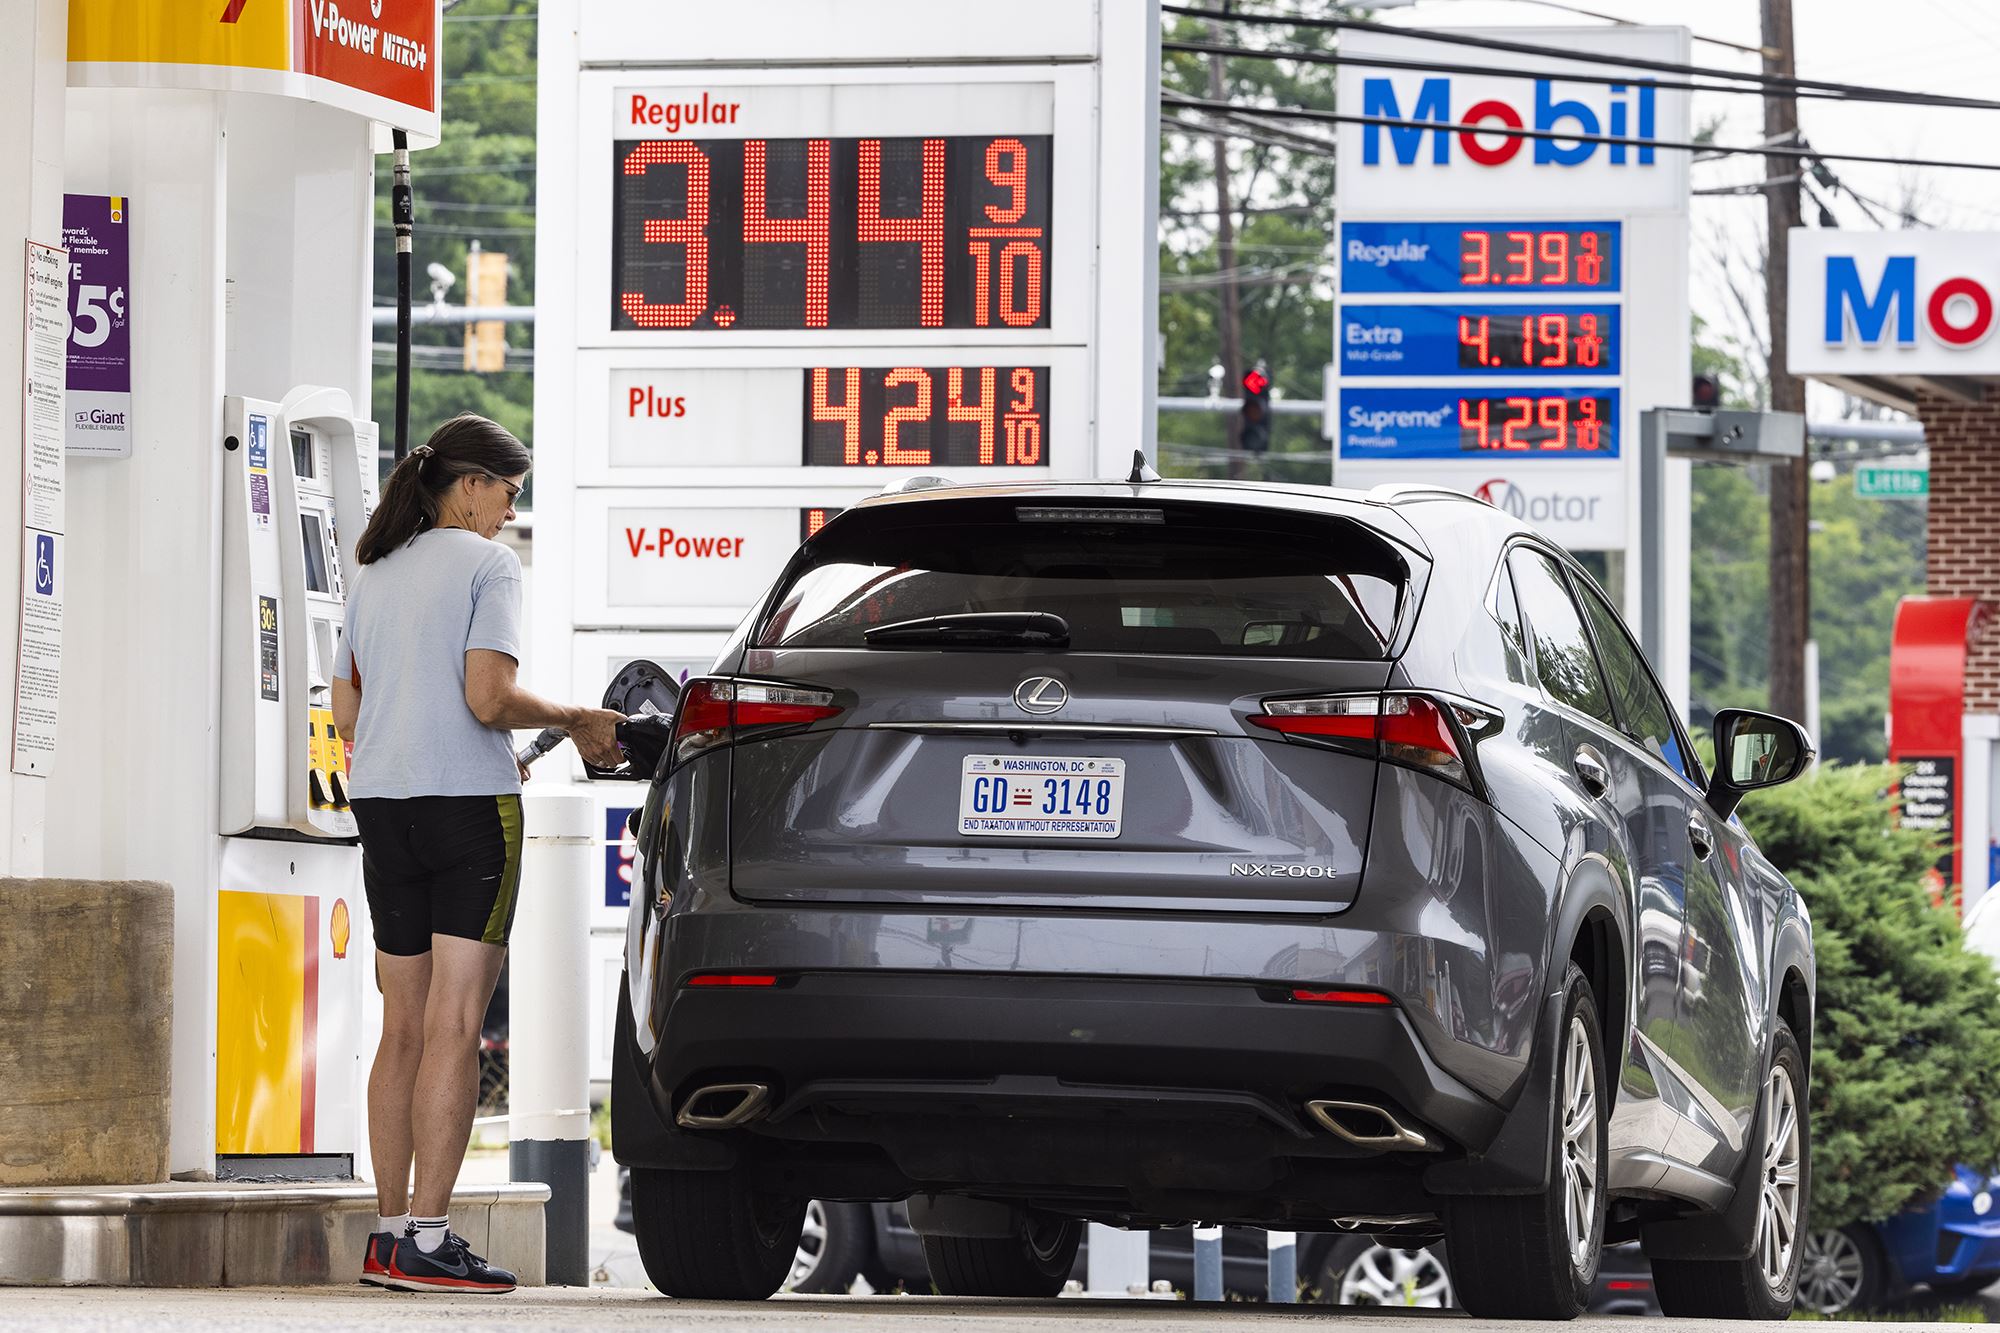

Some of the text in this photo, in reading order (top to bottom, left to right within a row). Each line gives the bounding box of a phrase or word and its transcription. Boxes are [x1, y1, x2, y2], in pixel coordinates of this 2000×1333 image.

[310, 0, 377, 55] V-Power
[631, 92, 740, 133] Regular
[1363, 78, 1656, 165] Mobil
[69, 236, 98, 245] Flexible
[622, 139, 946, 328] 3.44
[74, 246, 109, 255] members
[1347, 239, 1429, 266] Regular
[1460, 231, 1568, 285] 3.39
[1346, 323, 1403, 345] Extra
[1458, 314, 1568, 367] 4.19
[90, 409, 125, 424] Giant
[100, 424, 125, 432] REWARDS
[628, 385, 687, 418] Plus
[812, 367, 995, 465] 4.24
[1458, 397, 1568, 450] 4.29
[1347, 434, 1398, 447] Premium
[1861, 470, 1922, 492] Little
[626, 527, 744, 558] V-Power
[1003, 760, 1085, 773] WASHINGTON, DC
[973, 777, 1111, 815] GD 3148
[964, 820, 1116, 833] END TAXATION WITHOUT REPRESENTATION
[1231, 862, 1338, 879] NX 200t
